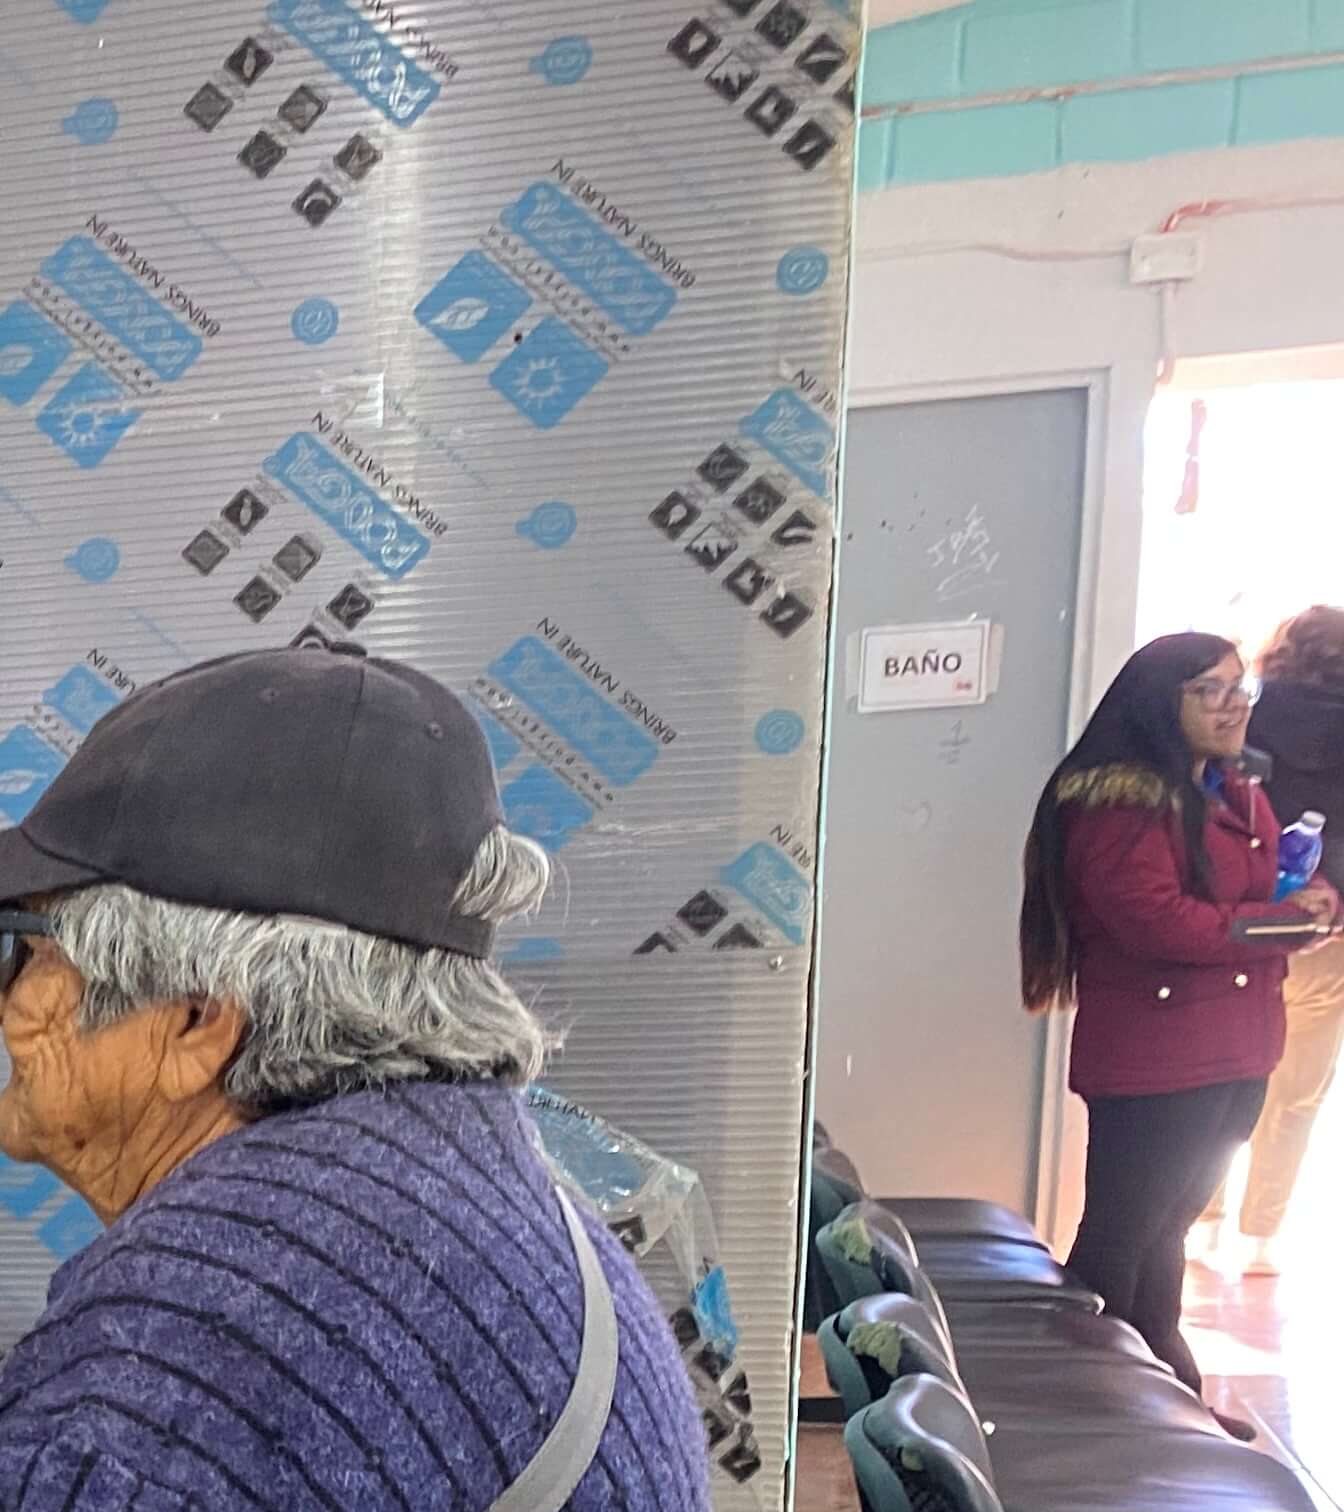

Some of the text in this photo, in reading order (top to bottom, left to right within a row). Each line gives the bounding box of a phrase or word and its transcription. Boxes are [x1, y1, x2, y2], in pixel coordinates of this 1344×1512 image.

[85, 214, 108, 237] IN
[549, 158, 696, 289] BRINGS NATURE IN
[106, 233, 165, 288] NATURE
[163, 283, 221, 338] BRINGS
[791, 368, 816, 393] IN
[310, 411, 448, 537] BRINGS NATURE IN
[85, 647, 107, 668] IN
[884, 648, 962, 678] BAÑO
[536, 615, 677, 745] BRINGS NATURE IN
[768, 823, 792, 846] IN
